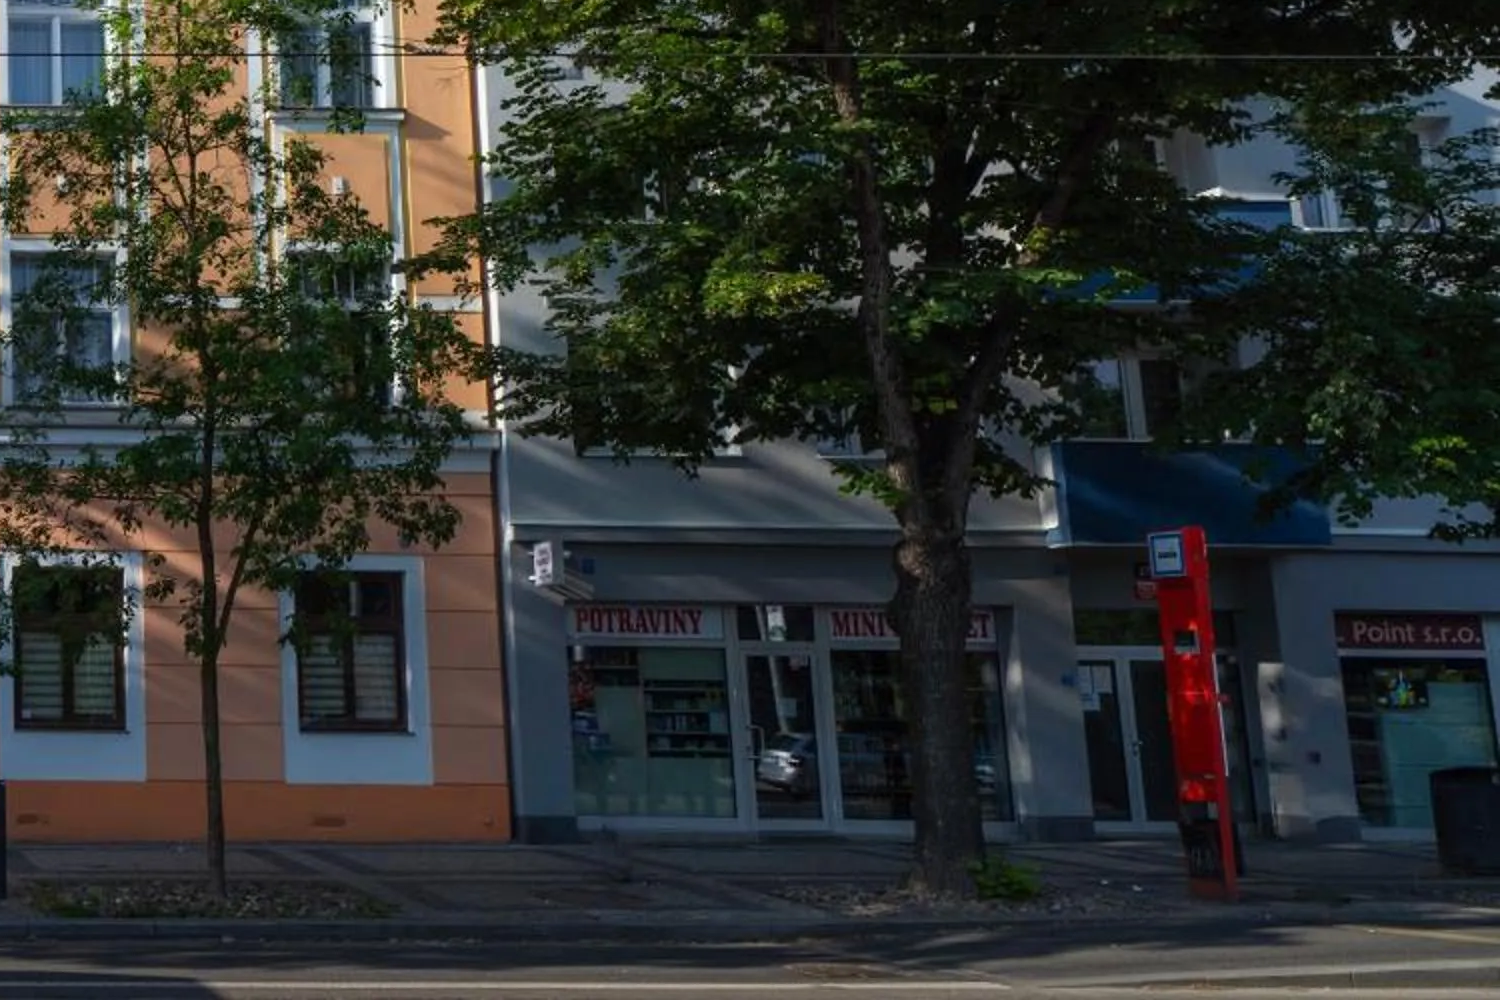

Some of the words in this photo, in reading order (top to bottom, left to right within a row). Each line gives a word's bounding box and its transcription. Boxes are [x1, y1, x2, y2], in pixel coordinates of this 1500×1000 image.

[574, 606, 703, 635] POTRAVINY
[1352, 619, 1416, 644] Point
[1422, 626, 1482, 644] s.r.o.
